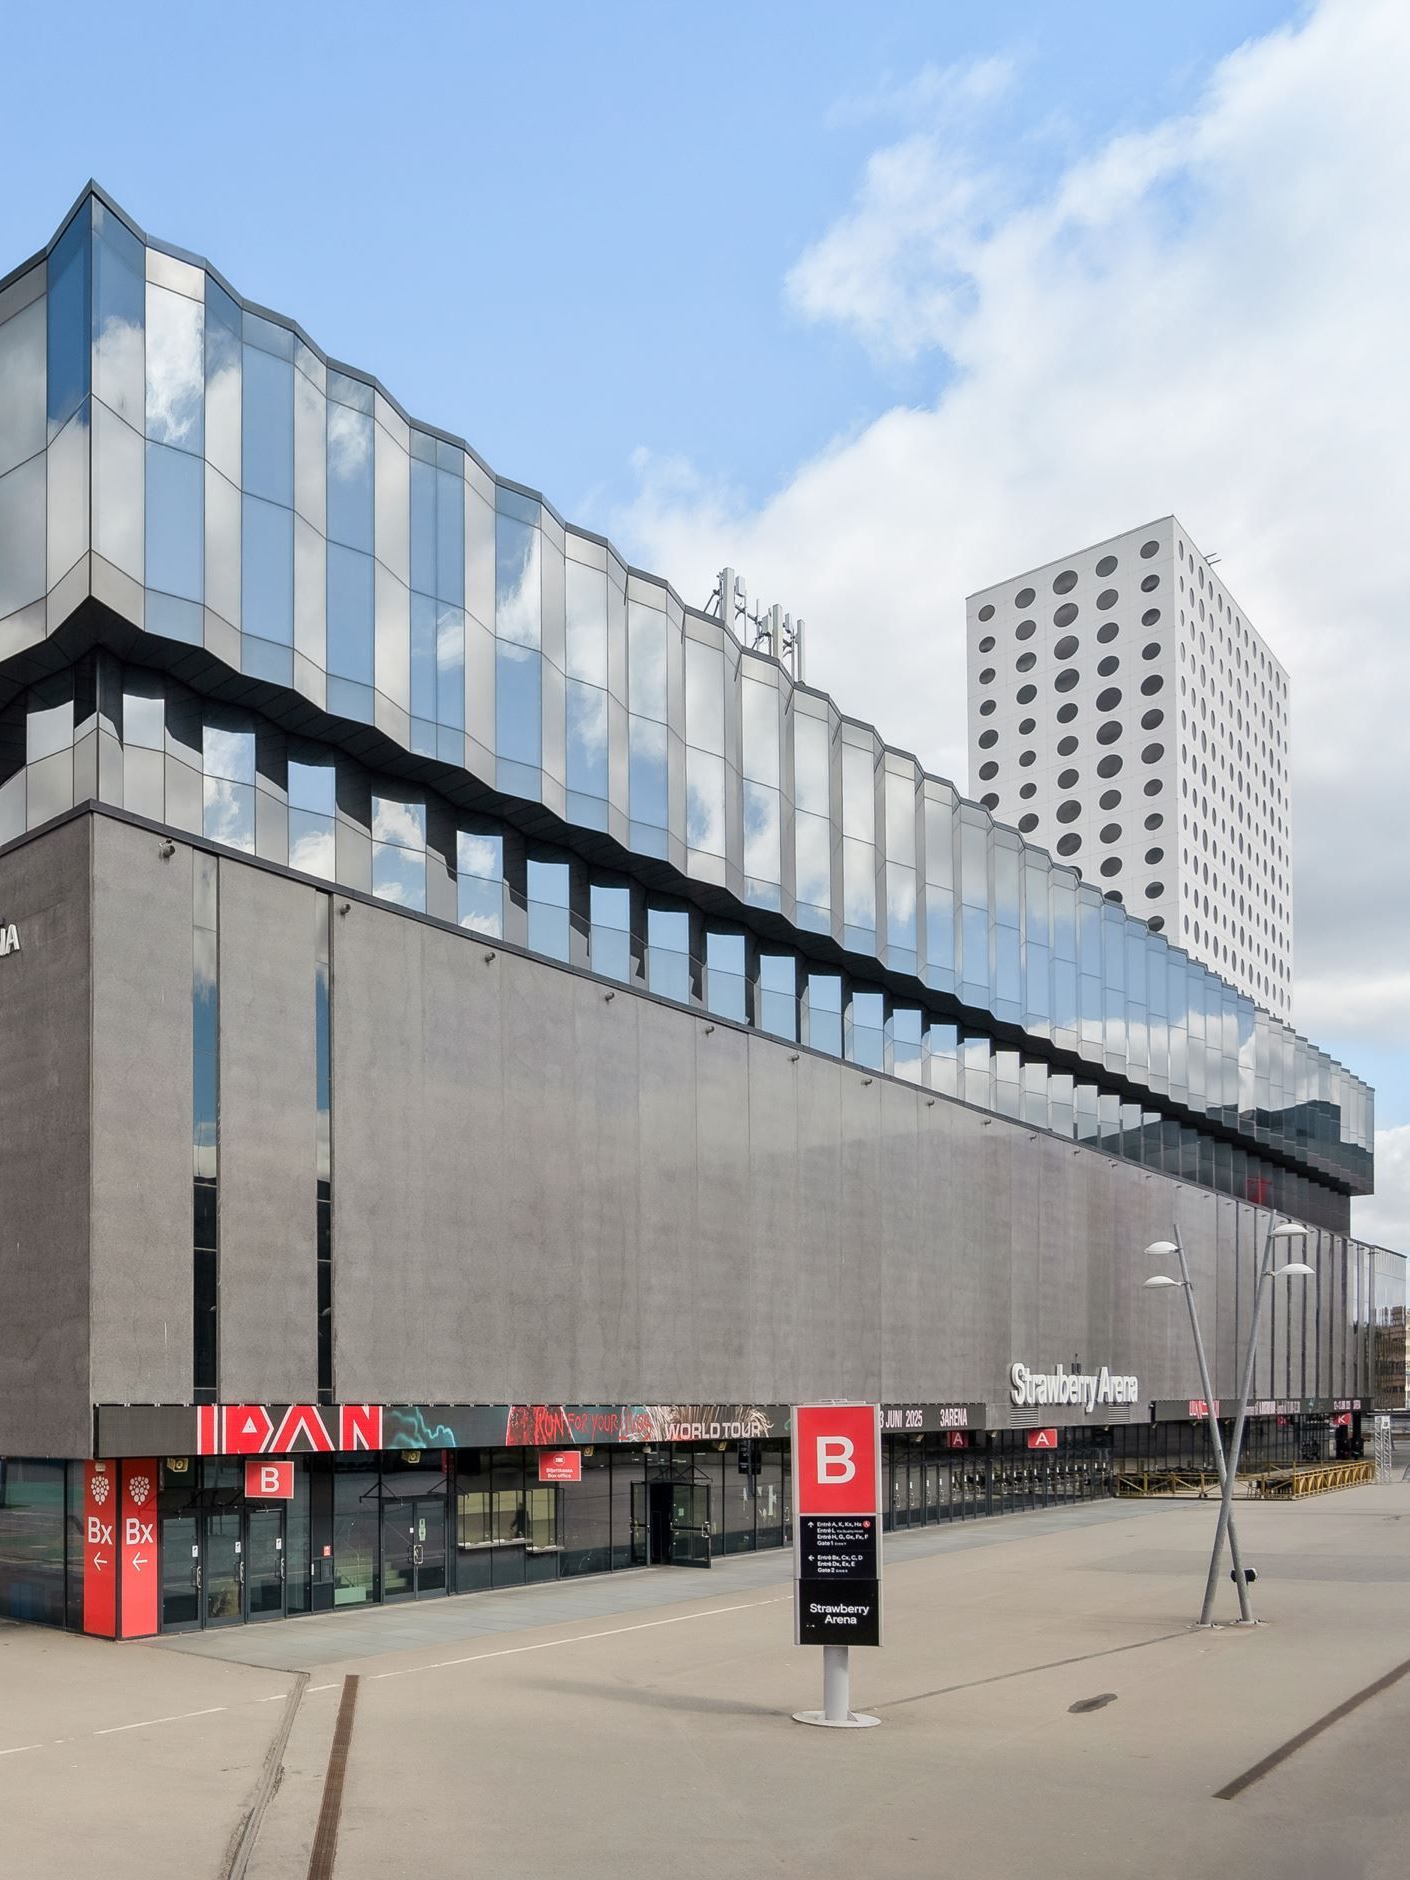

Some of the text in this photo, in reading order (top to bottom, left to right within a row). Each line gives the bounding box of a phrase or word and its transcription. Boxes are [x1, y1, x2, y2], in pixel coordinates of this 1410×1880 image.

[1011, 1362, 1138, 1413] Strawberry Arena
[567, 1411, 590, 1435] FOR
[592, 1413, 618, 1440] YOUR
[886, 1410, 903, 1428] JUNI
[906, 1410, 923, 1428] 2025
[940, 1408, 968, 1427] 3ARENA
[1338, 1414, 1346, 1424] K
[665, 1421, 762, 1441] WORLD TOUR
[1035, 1433, 1049, 1446] A
[816, 1436, 856, 1485] B
[261, 1466, 280, 1492] B
[88, 1516, 113, 1545] Bx
[126, 1517, 154, 1545] Bx
[810, 1603, 869, 1616] Strawberry
[824, 1614, 857, 1624] Arena
